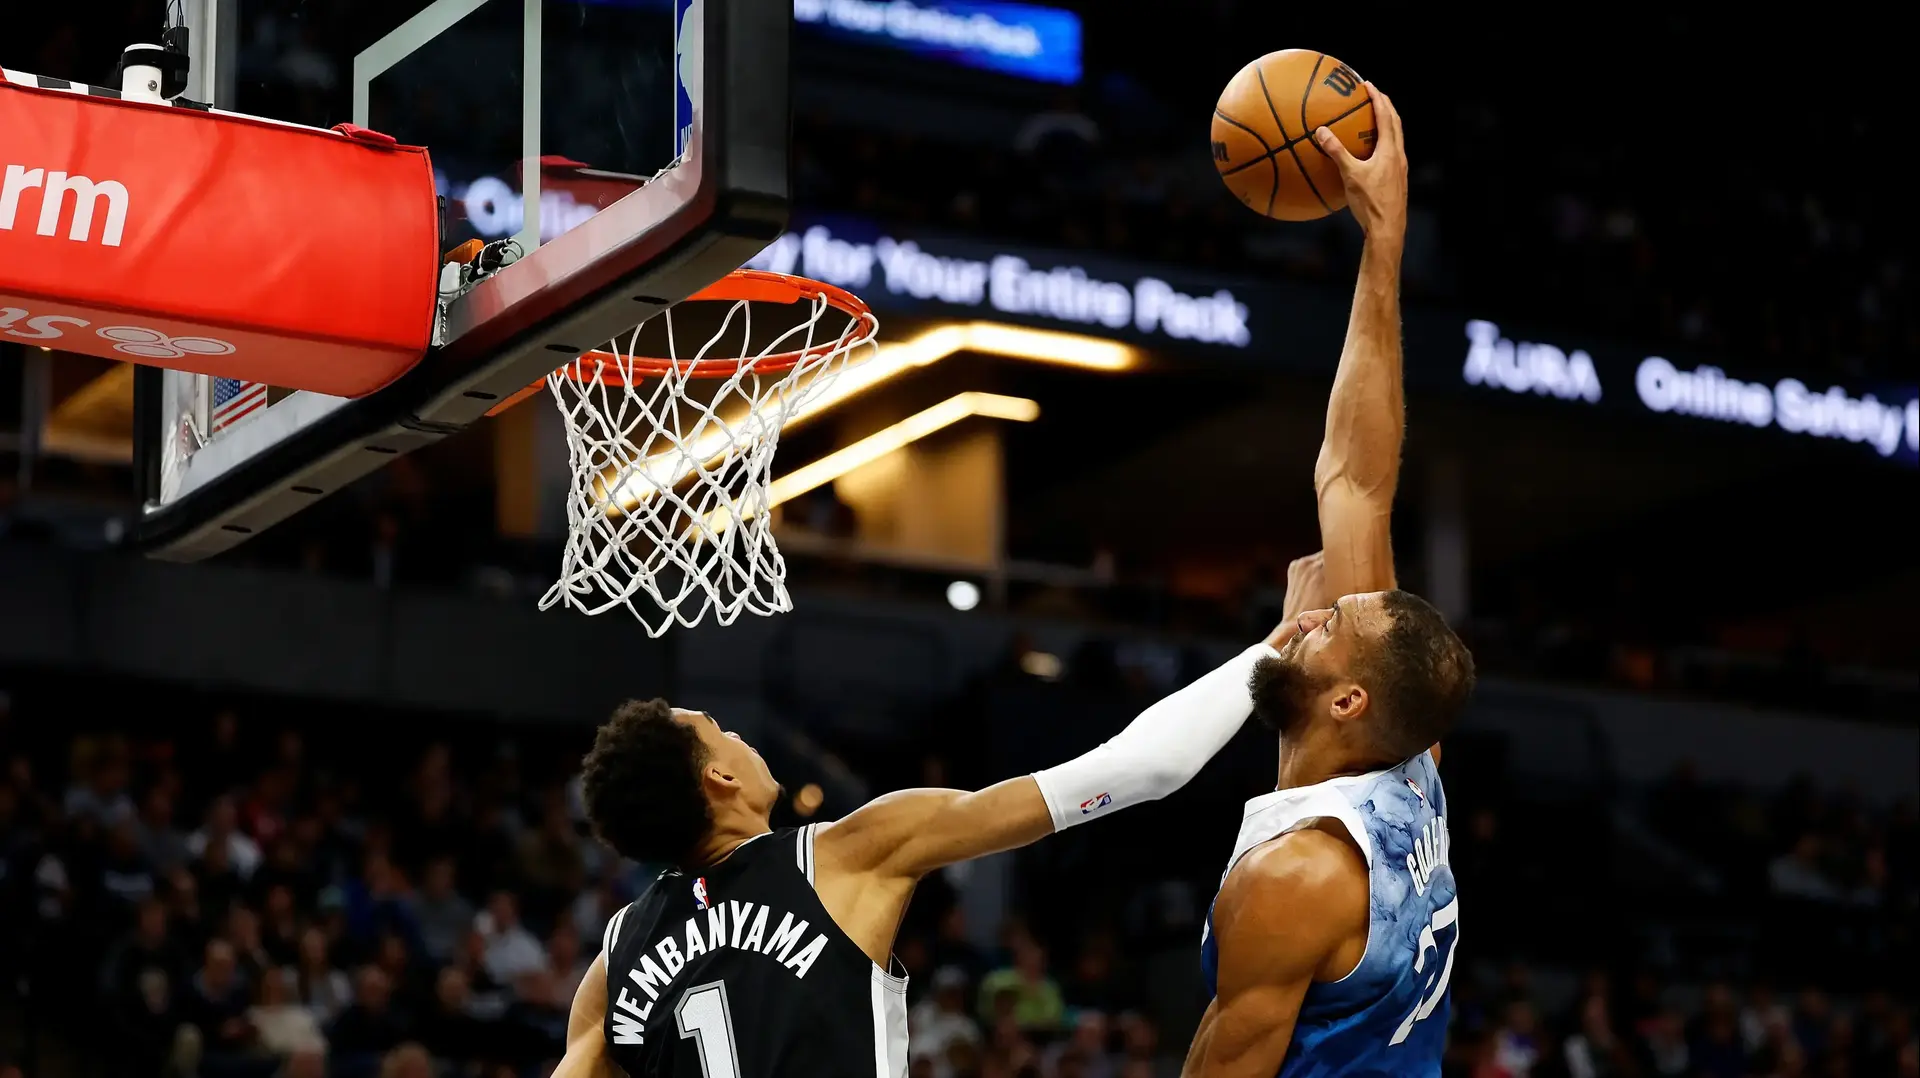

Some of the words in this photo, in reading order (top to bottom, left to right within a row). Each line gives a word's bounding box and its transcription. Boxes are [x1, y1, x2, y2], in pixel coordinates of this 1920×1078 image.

[803, 225, 872, 287] for
[877, 236, 987, 305] Your
[989, 254, 1132, 328] Entire
[1134, 277, 1250, 347] Pack
[1635, 356, 1773, 427] Online
[1774, 378, 1902, 456] Safety
[613, 900, 828, 1044] WEMBANYAMA
[674, 979, 742, 1078] 1
